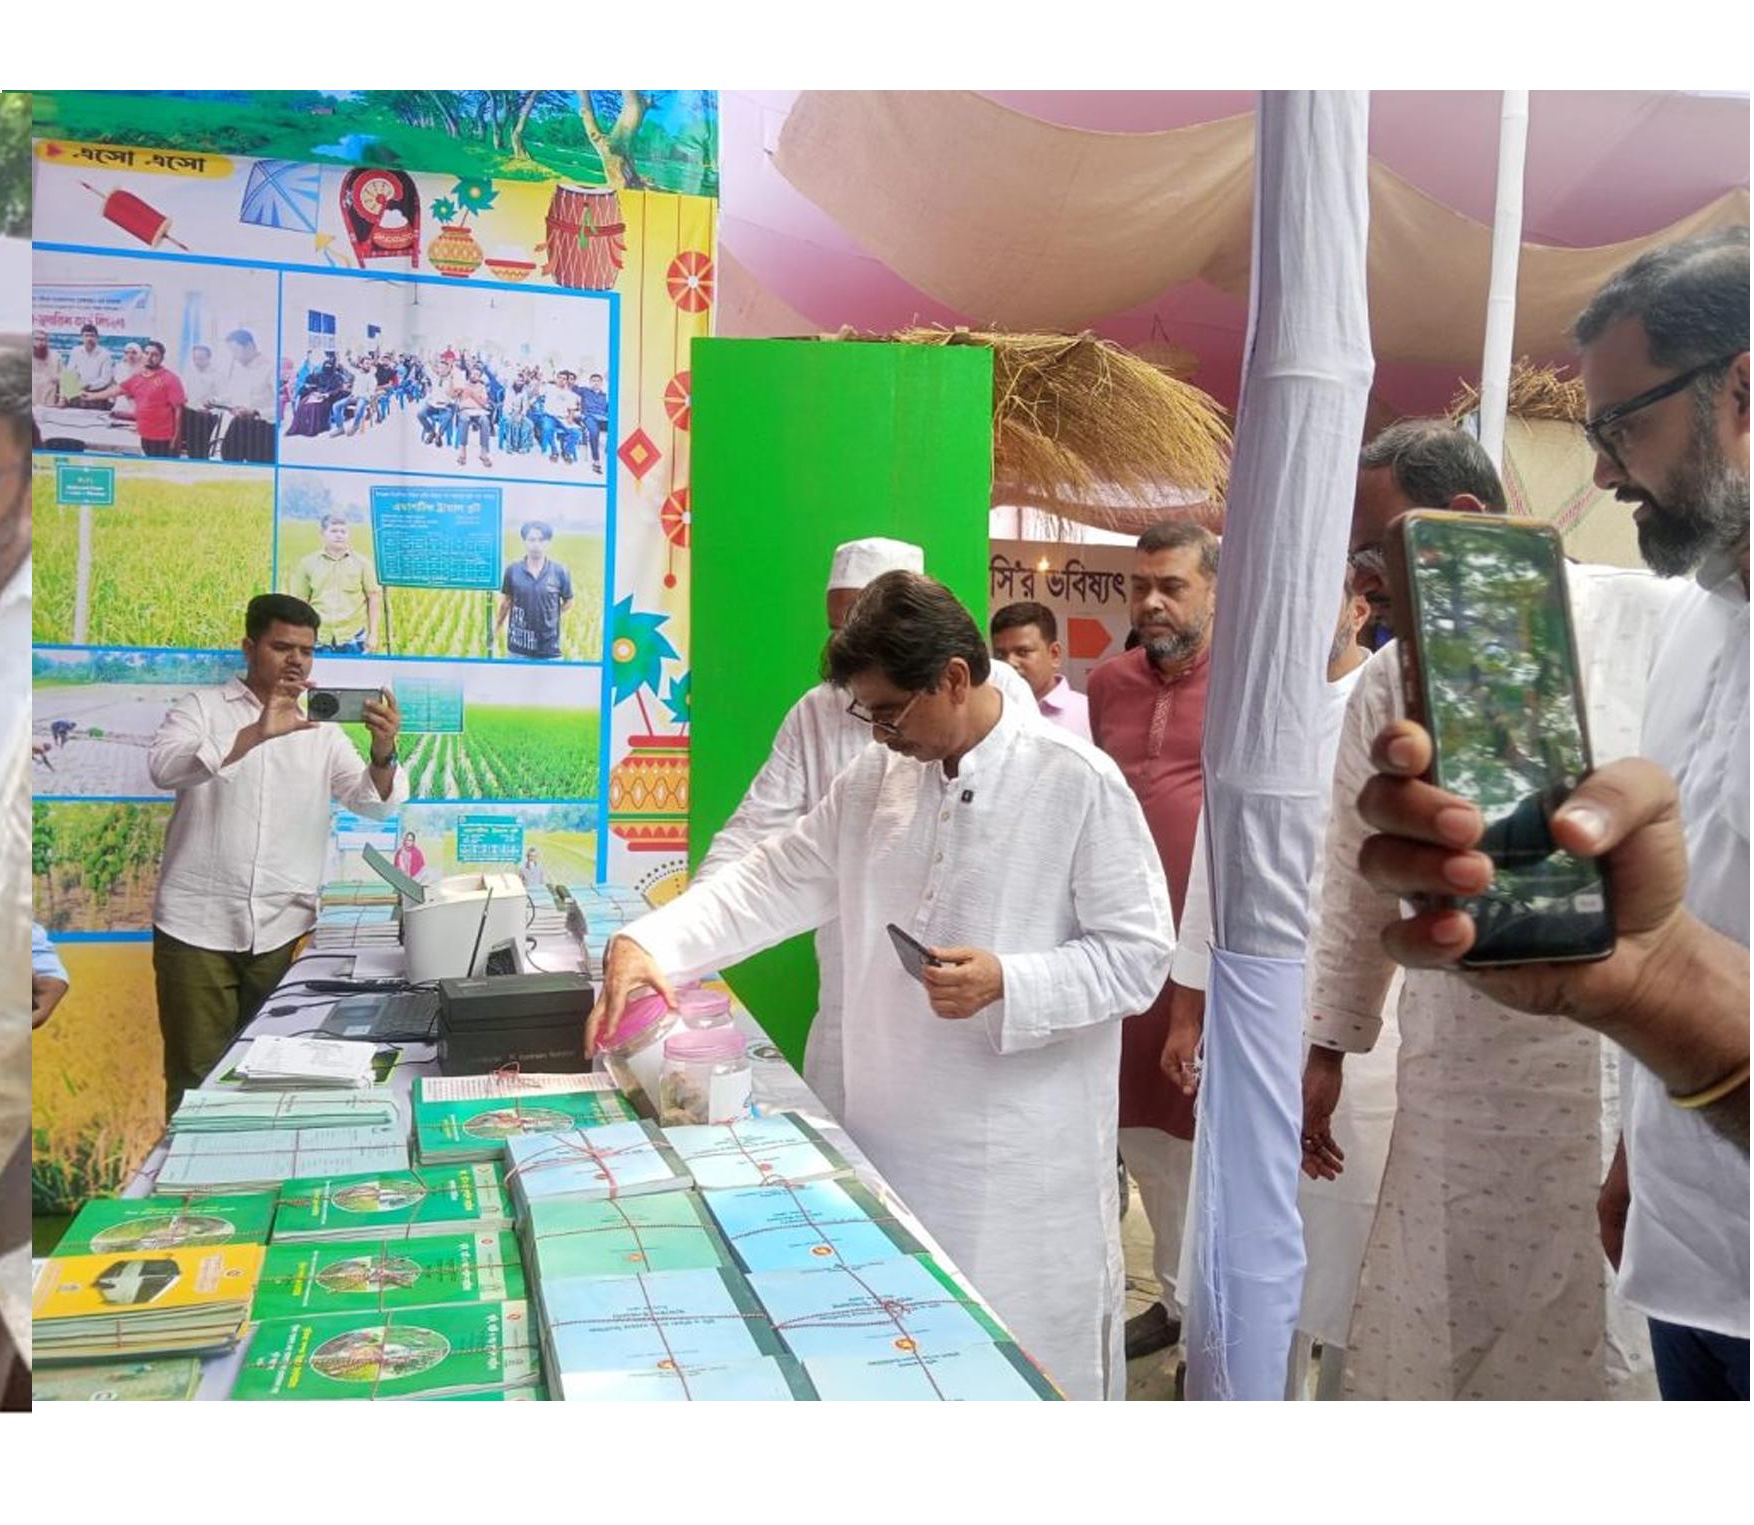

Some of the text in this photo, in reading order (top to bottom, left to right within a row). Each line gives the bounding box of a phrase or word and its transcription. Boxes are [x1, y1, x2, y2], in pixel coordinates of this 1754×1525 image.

[73, 146, 206, 173] এসো এসো
[1047, 557, 1127, 604] ভবিষ্যৎ
